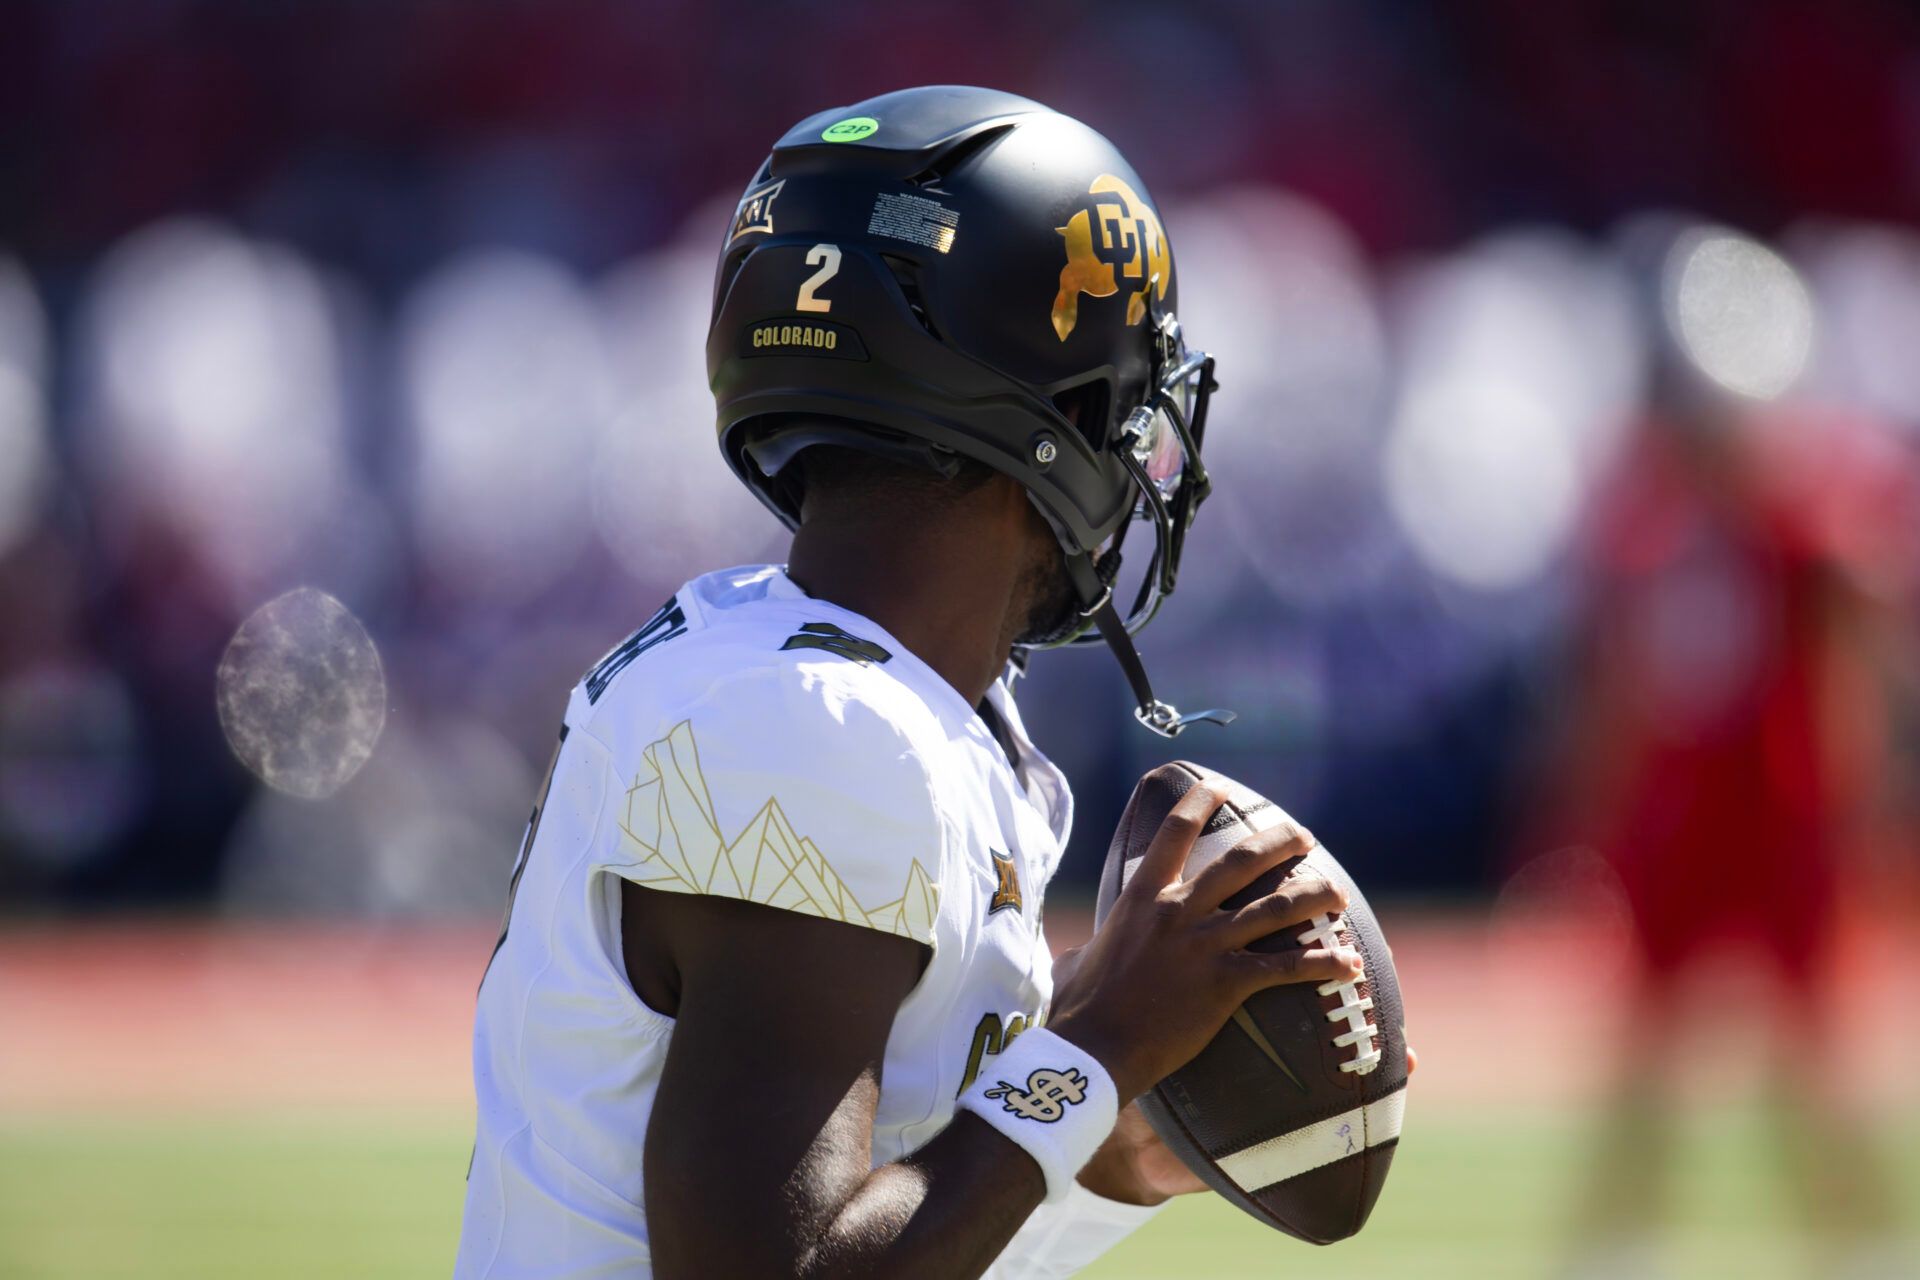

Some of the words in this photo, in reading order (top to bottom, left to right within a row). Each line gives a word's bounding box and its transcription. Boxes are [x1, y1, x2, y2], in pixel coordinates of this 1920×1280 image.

[829, 123, 872, 135] C2P
[898, 192, 942, 208] WARNING
[796, 243, 842, 313] 2
[753, 325, 837, 350] COLORADO
